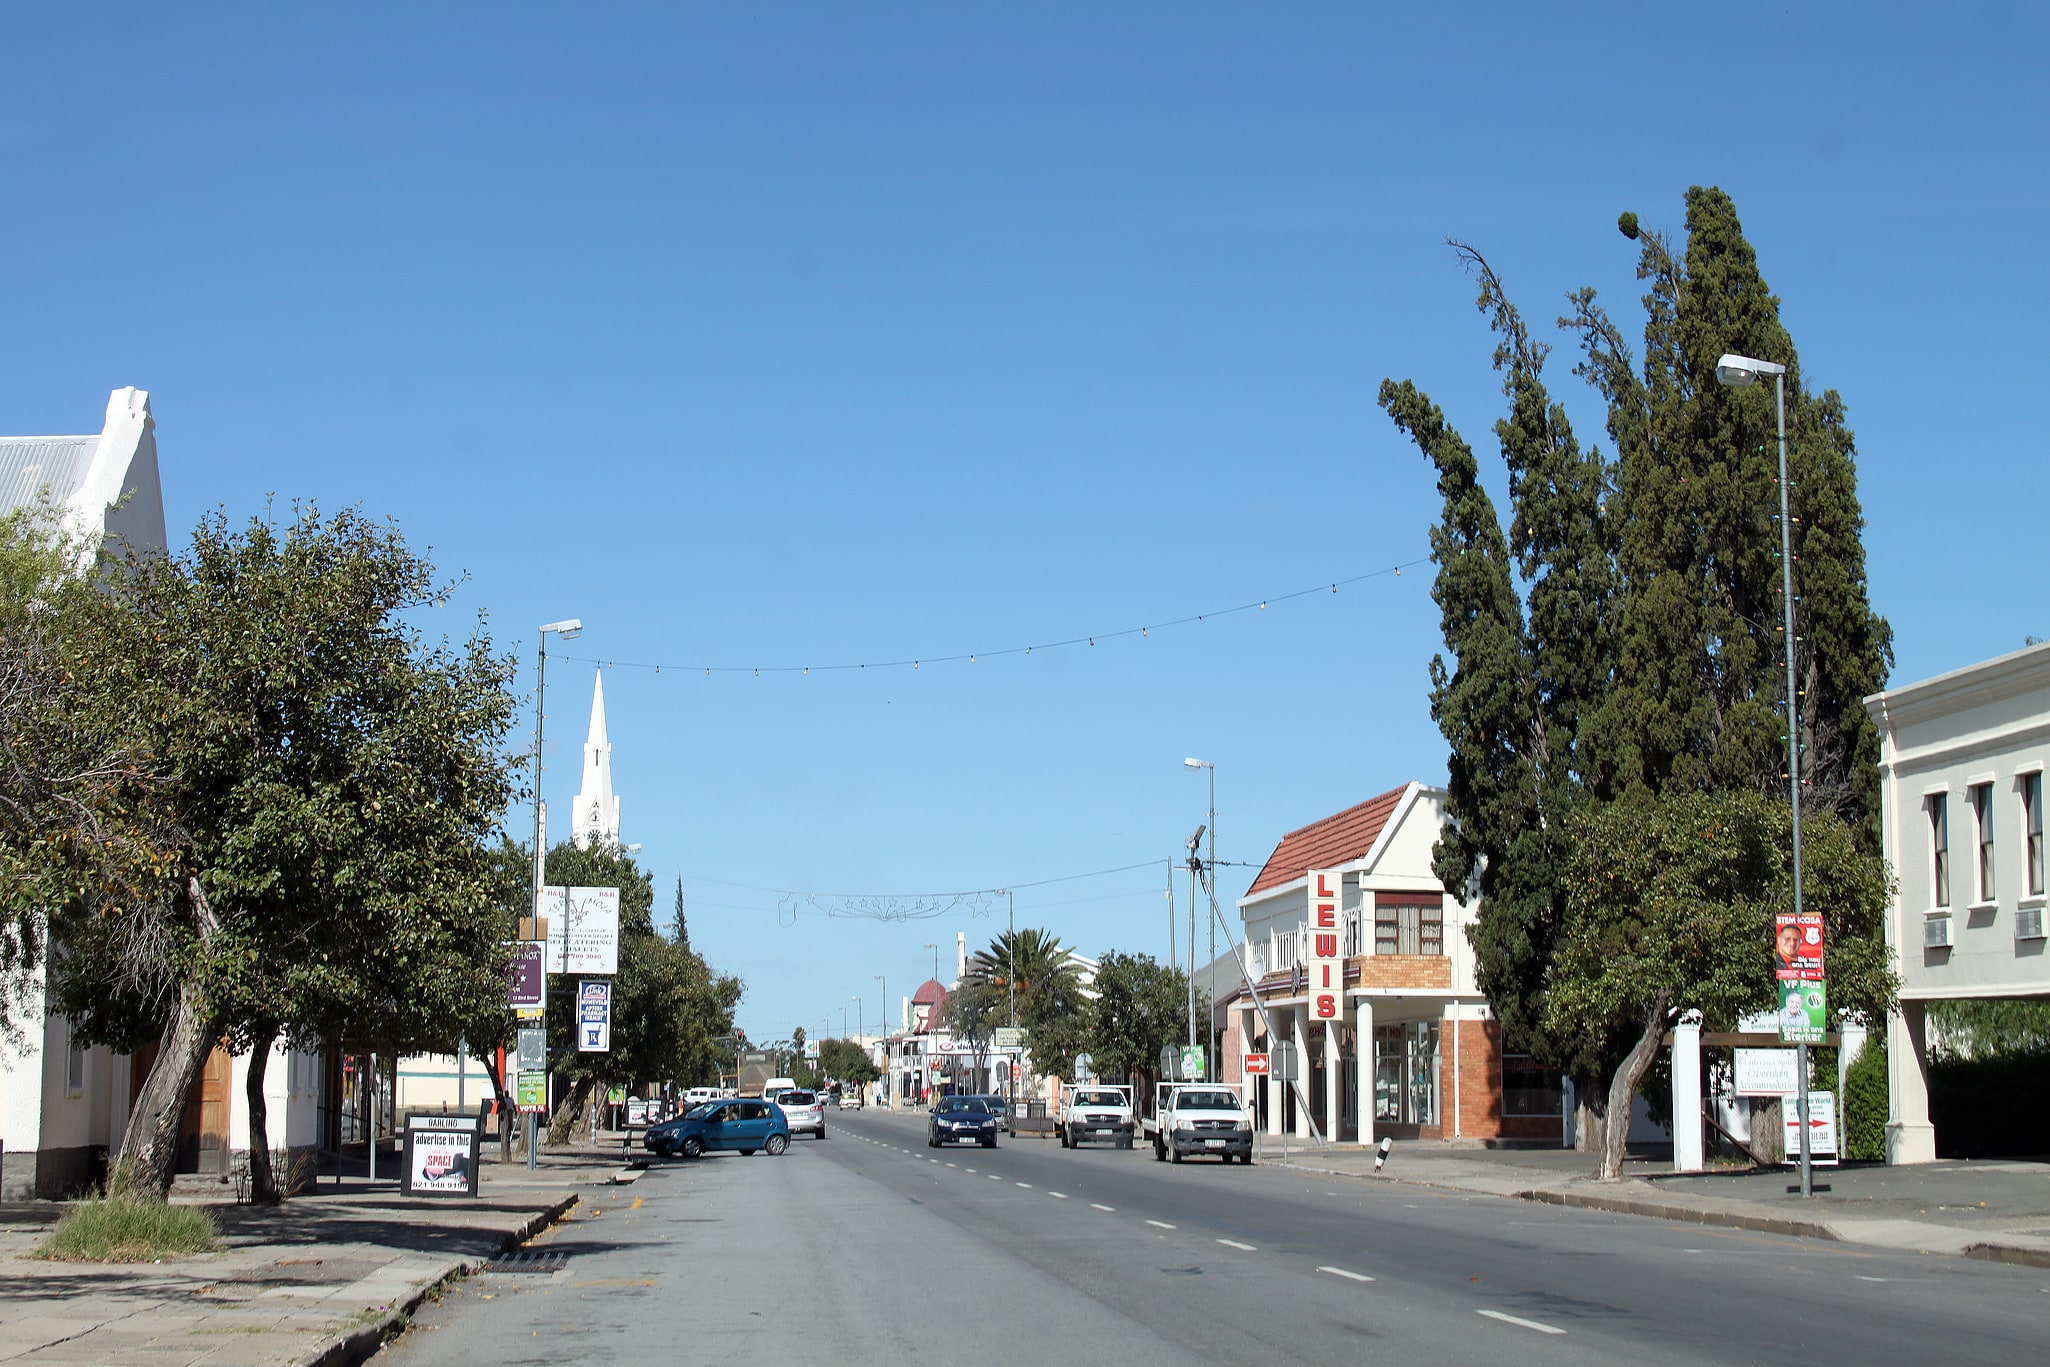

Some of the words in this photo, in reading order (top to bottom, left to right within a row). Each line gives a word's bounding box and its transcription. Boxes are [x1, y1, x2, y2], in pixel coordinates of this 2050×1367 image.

[1315, 873, 1337, 1018] LEWIS
[1782, 979, 1799, 990] VF
[1800, 980, 1822, 990] Plus
[1783, 1032, 1823, 1042] Sterker
[1814, 1097, 1832, 1105] World
[519, 1104, 537, 1113] VOTE
[428, 1119, 458, 1128] DARLING
[415, 1134, 447, 1146] advertise
[448, 1135, 456, 1146] in
[456, 1134, 470, 1147] this
[427, 1154, 453, 1168] SPACE
[412, 1181, 428, 1189] 021
